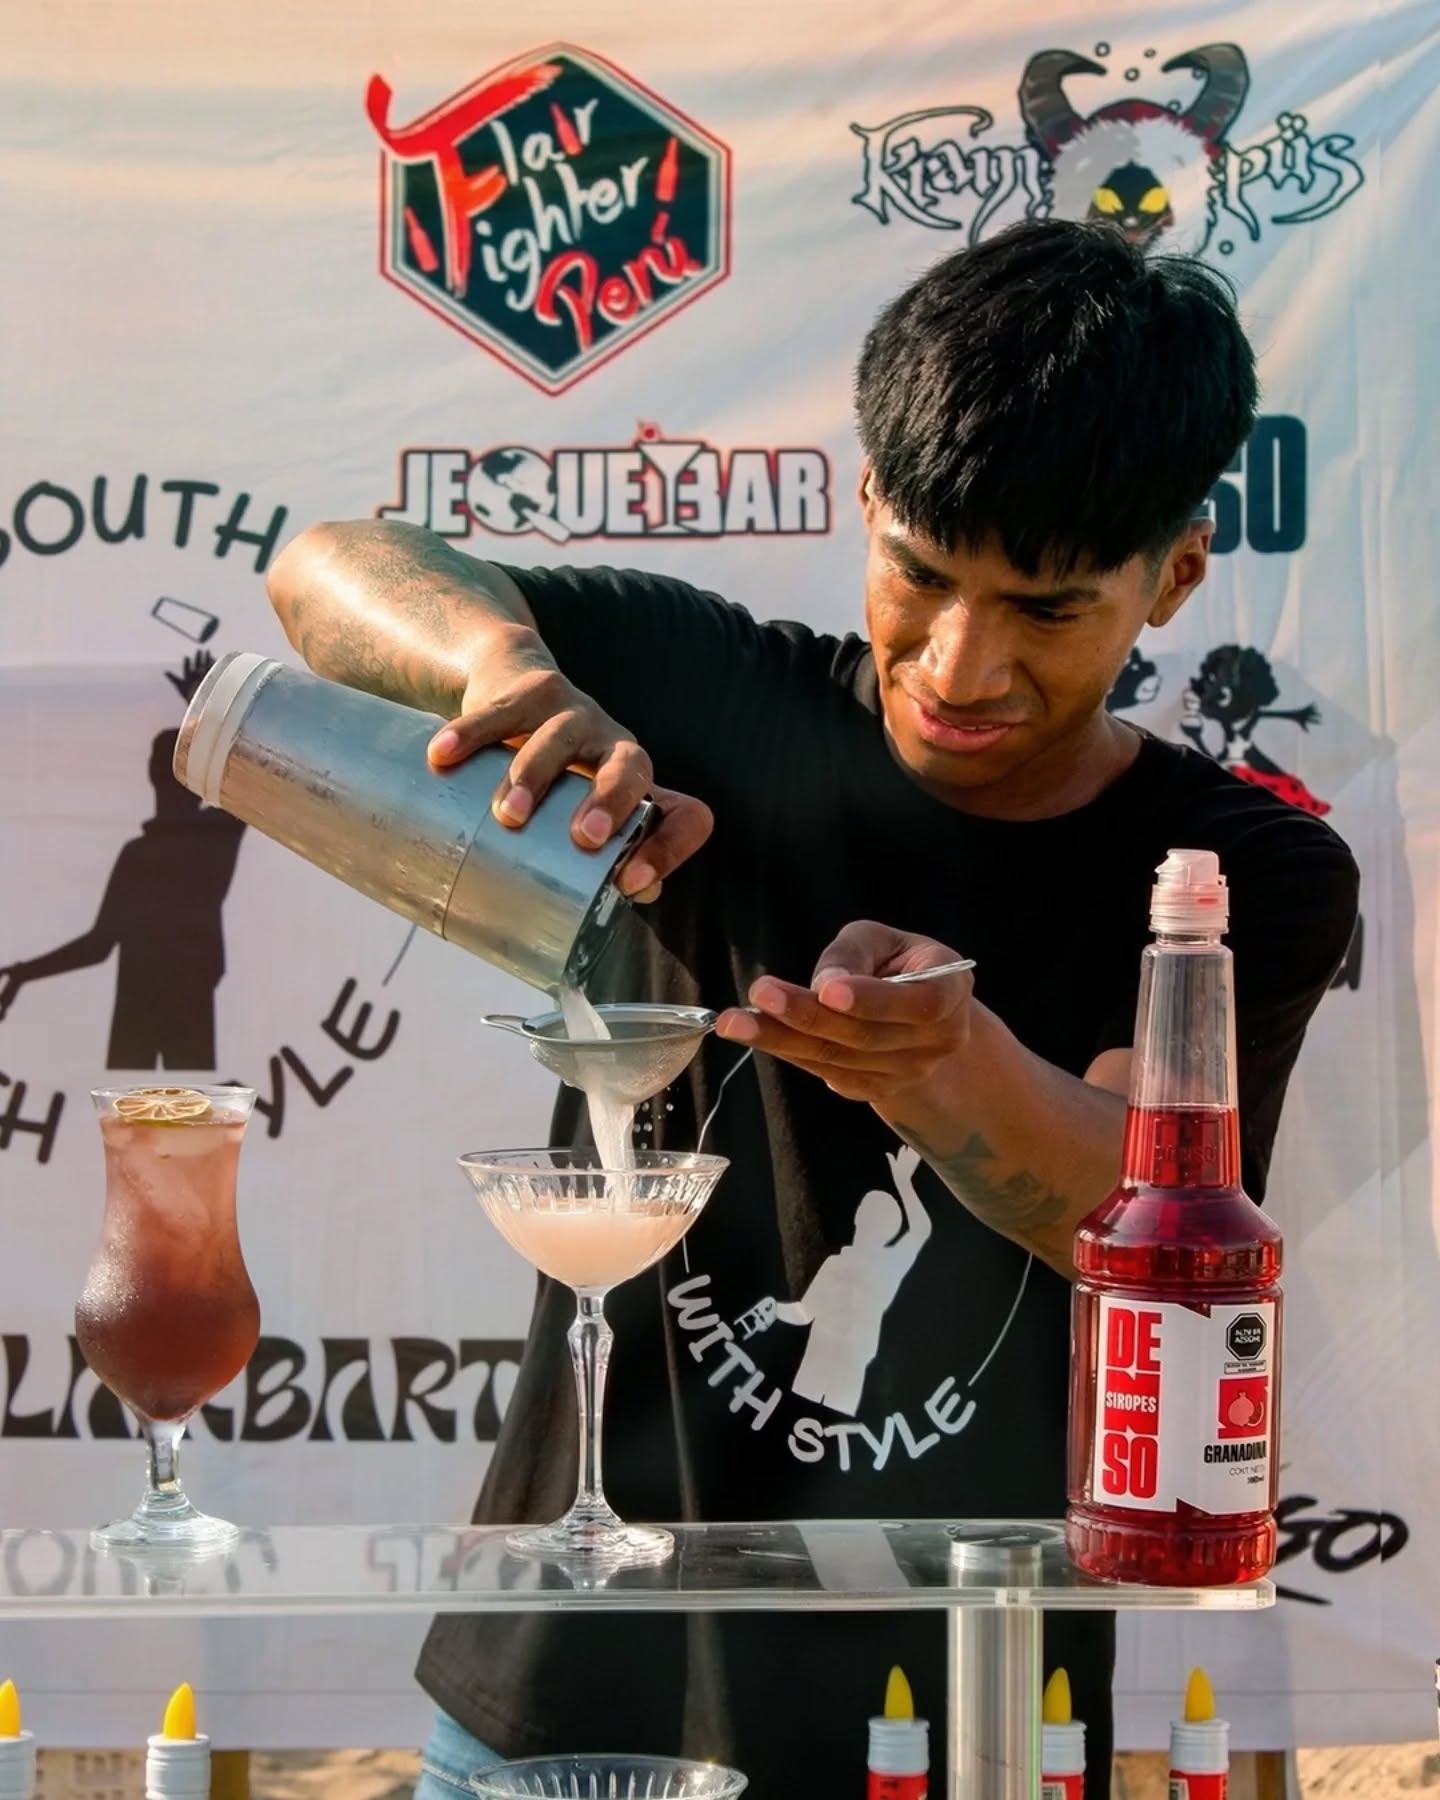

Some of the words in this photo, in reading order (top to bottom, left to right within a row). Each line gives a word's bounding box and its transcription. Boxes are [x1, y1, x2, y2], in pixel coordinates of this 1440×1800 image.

[0, 472, 289, 575] OUTH
[212, 977, 401, 1139] YLE
[667, 1274, 782, 1431] WITH
[787, 1376, 977, 1471] STYLE
[1106, 1307, 1162, 1372] DE
[1105, 1391, 1157, 1413] SIROPES
[1102, 1432, 1159, 1499] SO
